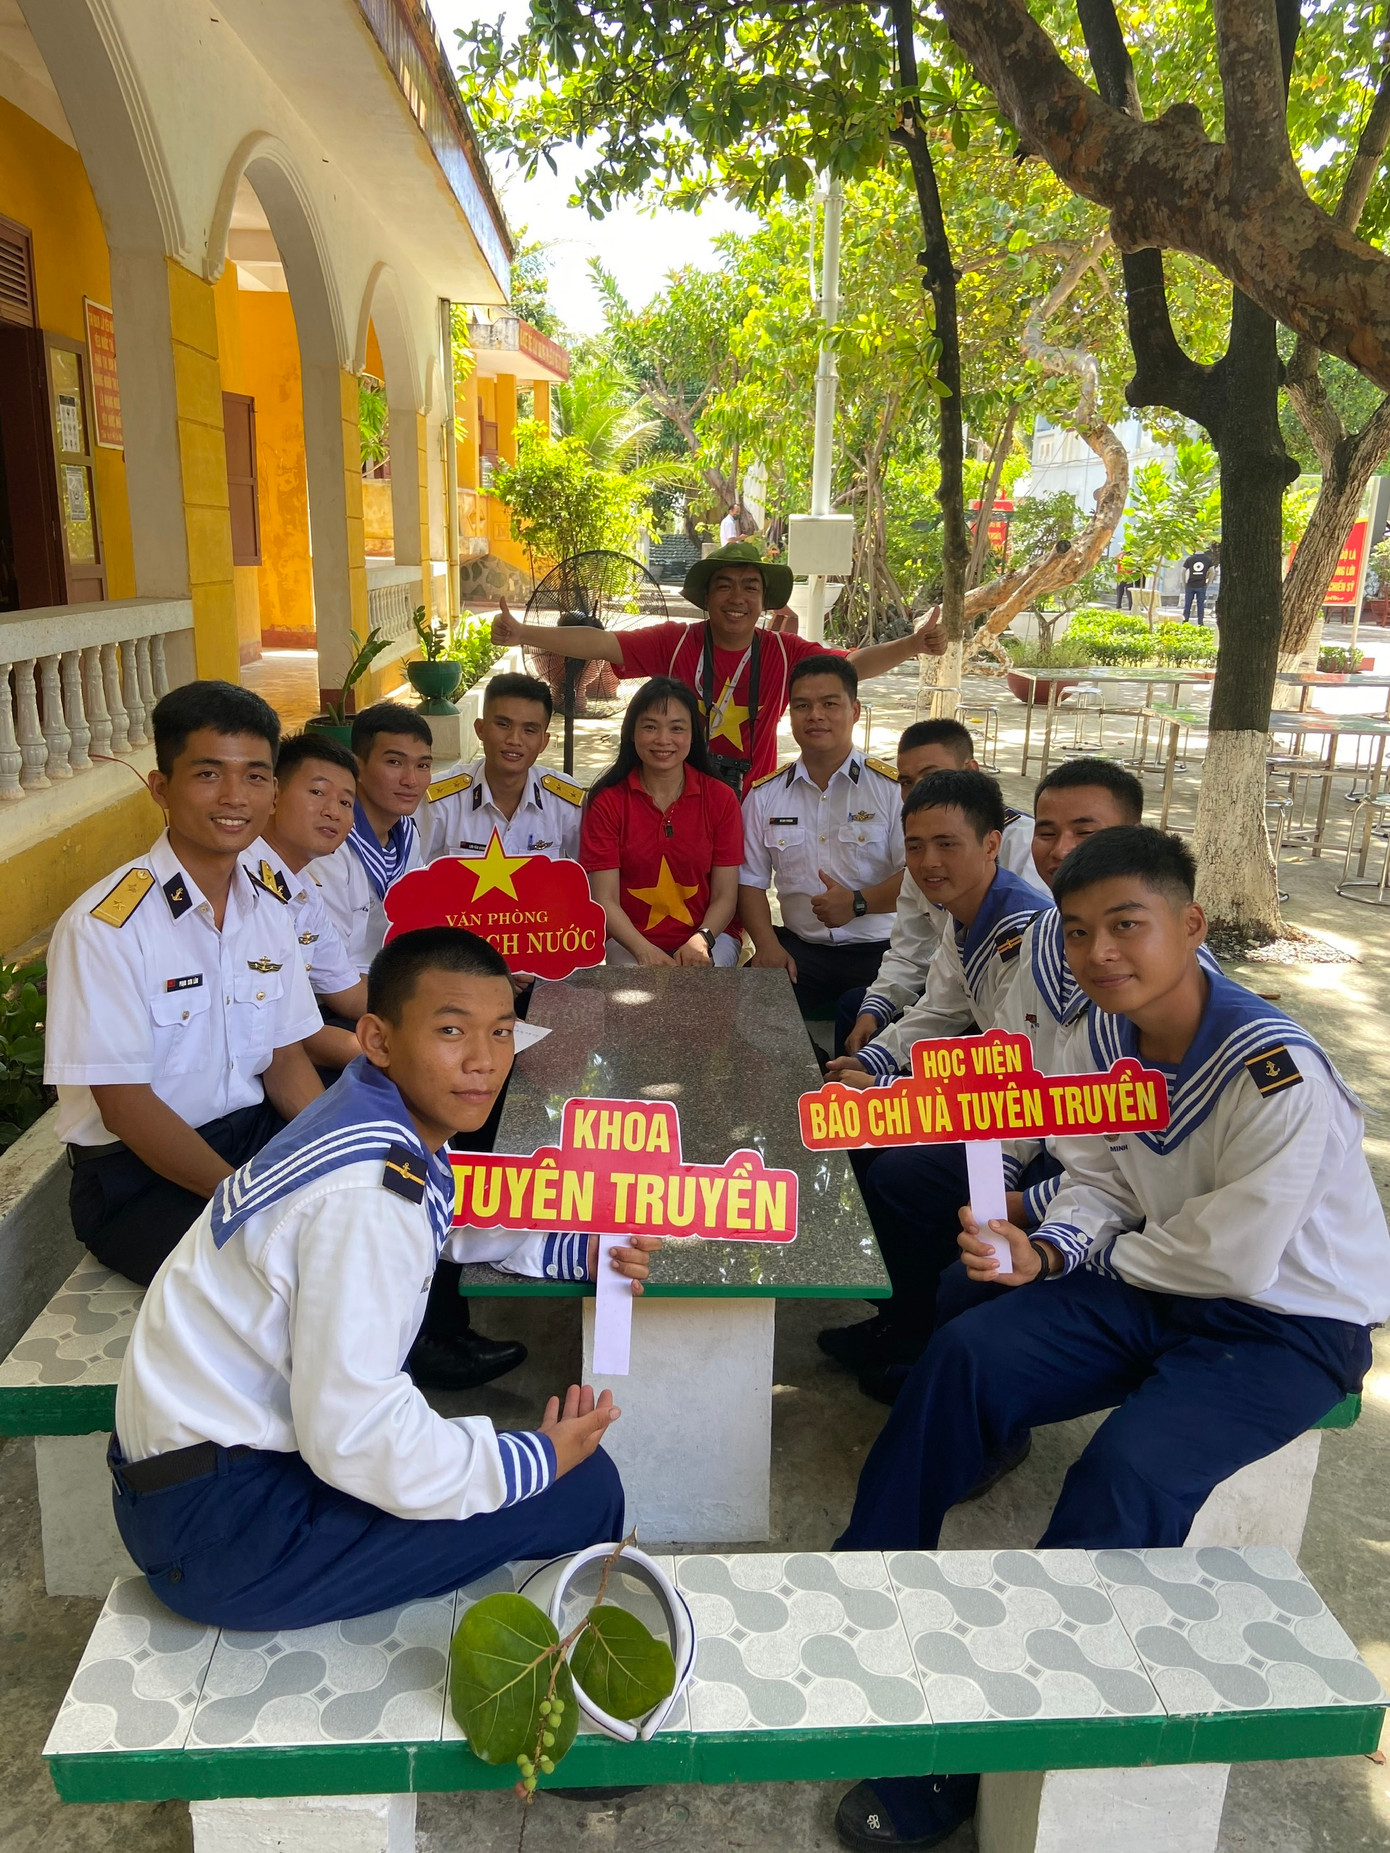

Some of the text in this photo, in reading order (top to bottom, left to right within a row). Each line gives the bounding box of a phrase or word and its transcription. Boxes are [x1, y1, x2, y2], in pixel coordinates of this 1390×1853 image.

[445, 908, 549, 927] VĂN PHÒNG
[478, 923, 597, 955] CH NƯỚC
[922, 1039, 1023, 1084] HỌC VIỆN
[808, 1068, 1159, 1140] BÁO CHÍ VÀ TUYÊN TRUYỀN
[572, 1108, 671, 1153] KHOA
[452, 1157, 788, 1232] TUYÊN TRUYỀN
